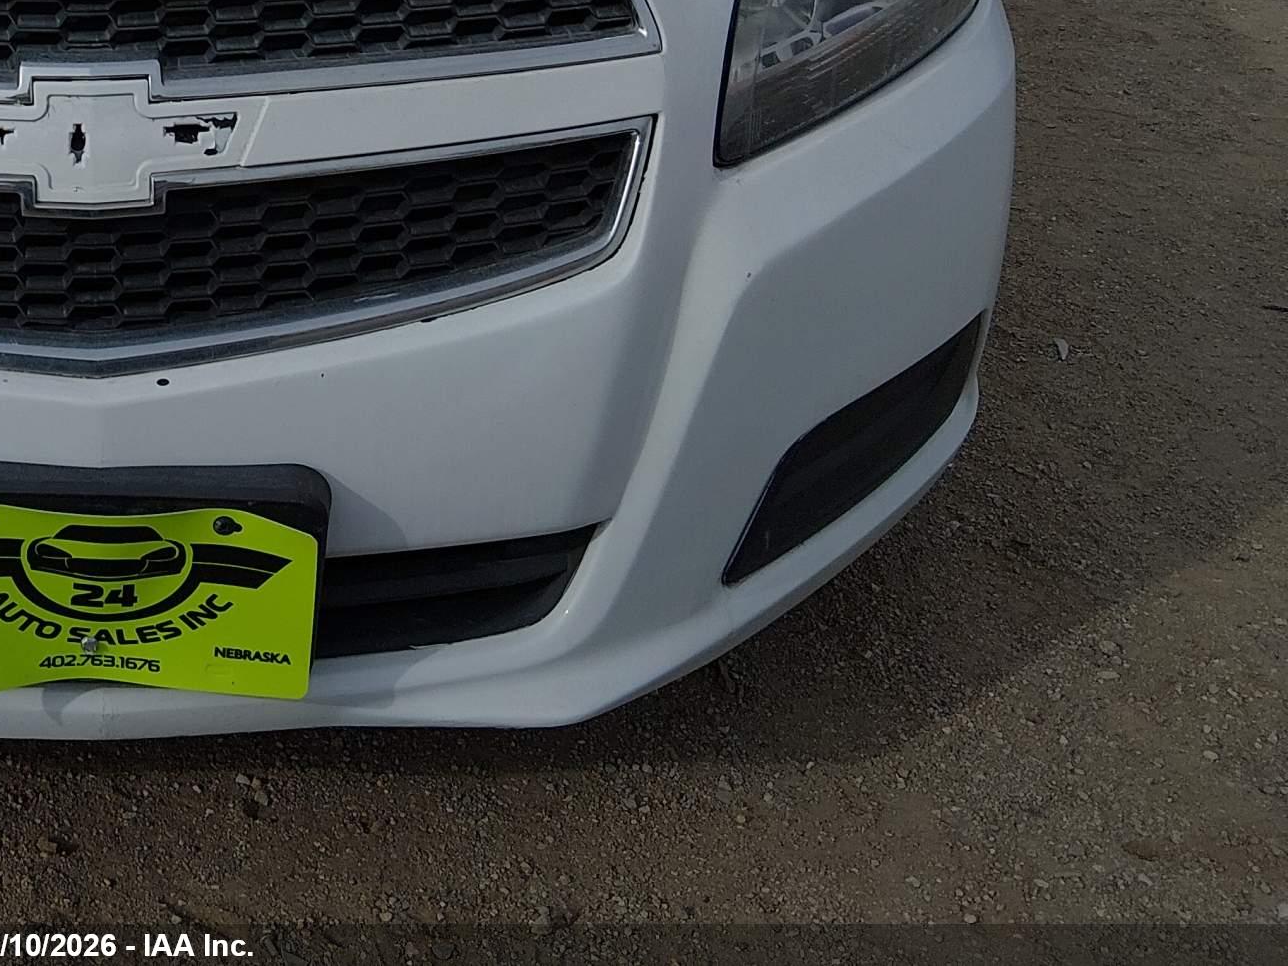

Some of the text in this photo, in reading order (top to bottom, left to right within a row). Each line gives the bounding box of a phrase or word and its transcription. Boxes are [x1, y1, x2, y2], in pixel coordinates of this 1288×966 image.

[70, 583, 139, 608] 24
[66, 620, 183, 646] SALES
[178, 593, 234, 631] INC
[38, 653, 161, 672] 402.763.1676
[214, 646, 292, 666] NEBRASKA
